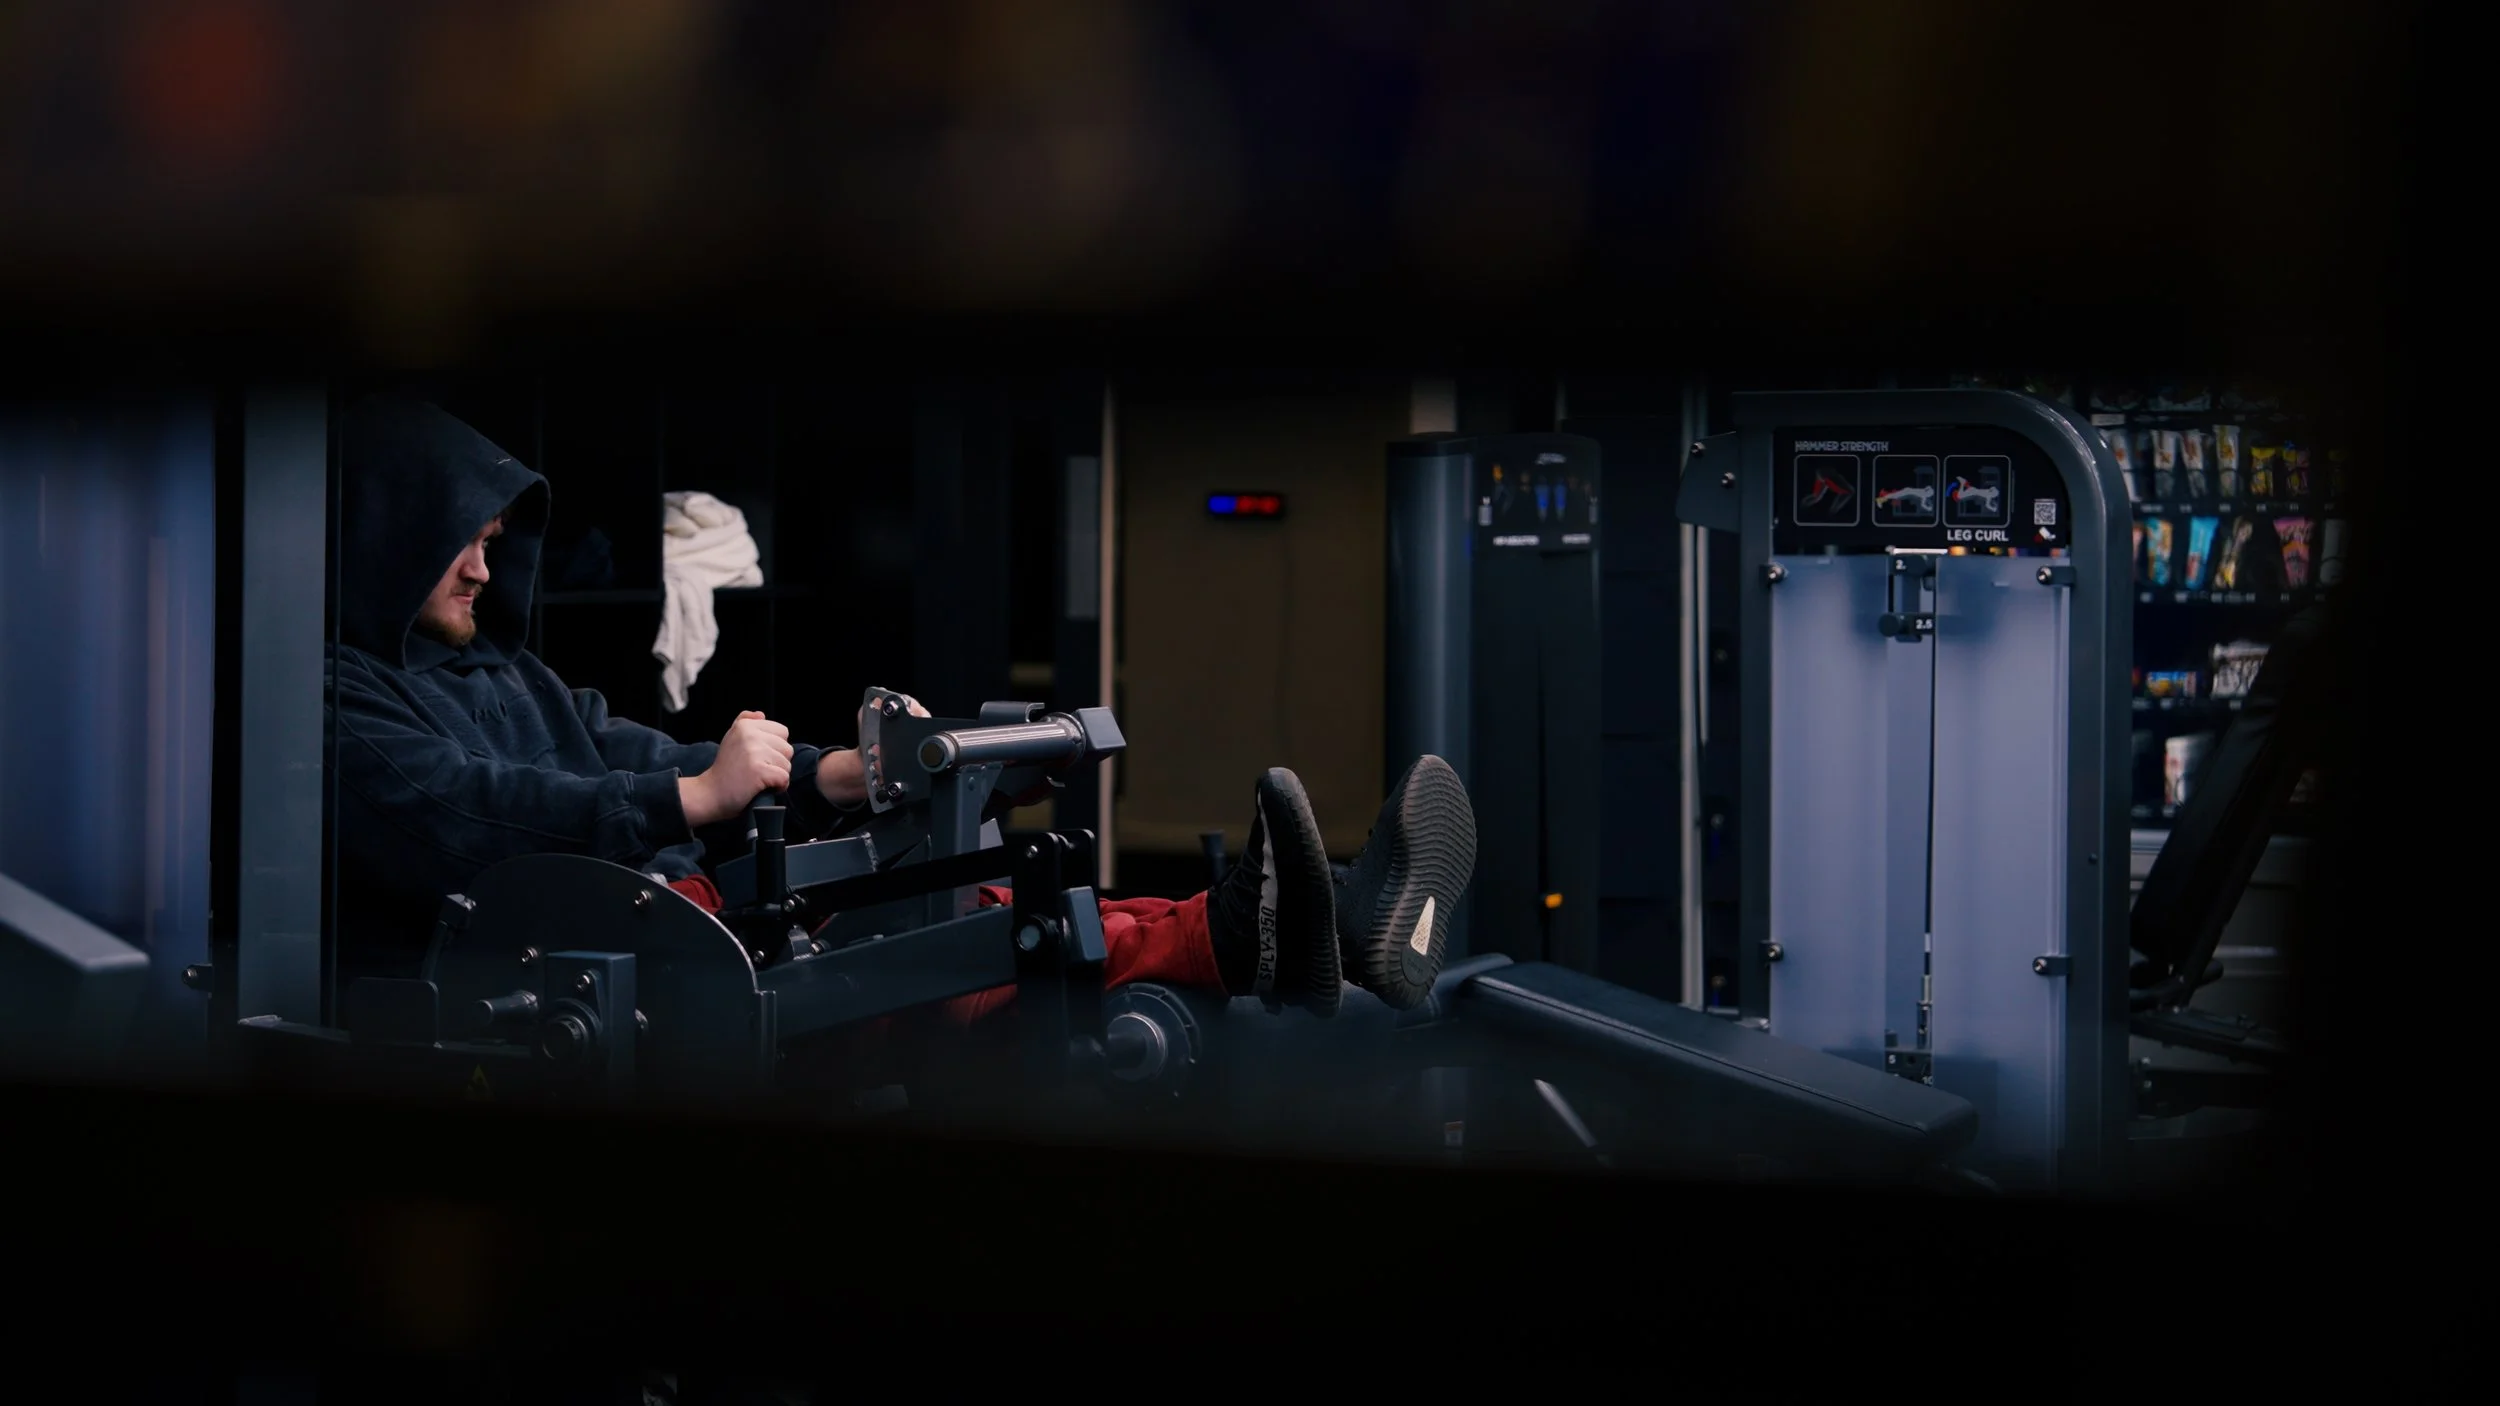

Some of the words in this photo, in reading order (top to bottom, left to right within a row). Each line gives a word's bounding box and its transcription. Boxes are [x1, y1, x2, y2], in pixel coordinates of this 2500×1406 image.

[1795, 440, 1839, 452] HAMMER
[1840, 440, 1889, 452] STRENGTH
[1946, 529, 1972, 541] LEG
[1975, 529, 2009, 542] CURL
[1915, 618, 1933, 630] 2.5
[1259, 906, 1275, 981] SPLY-350
